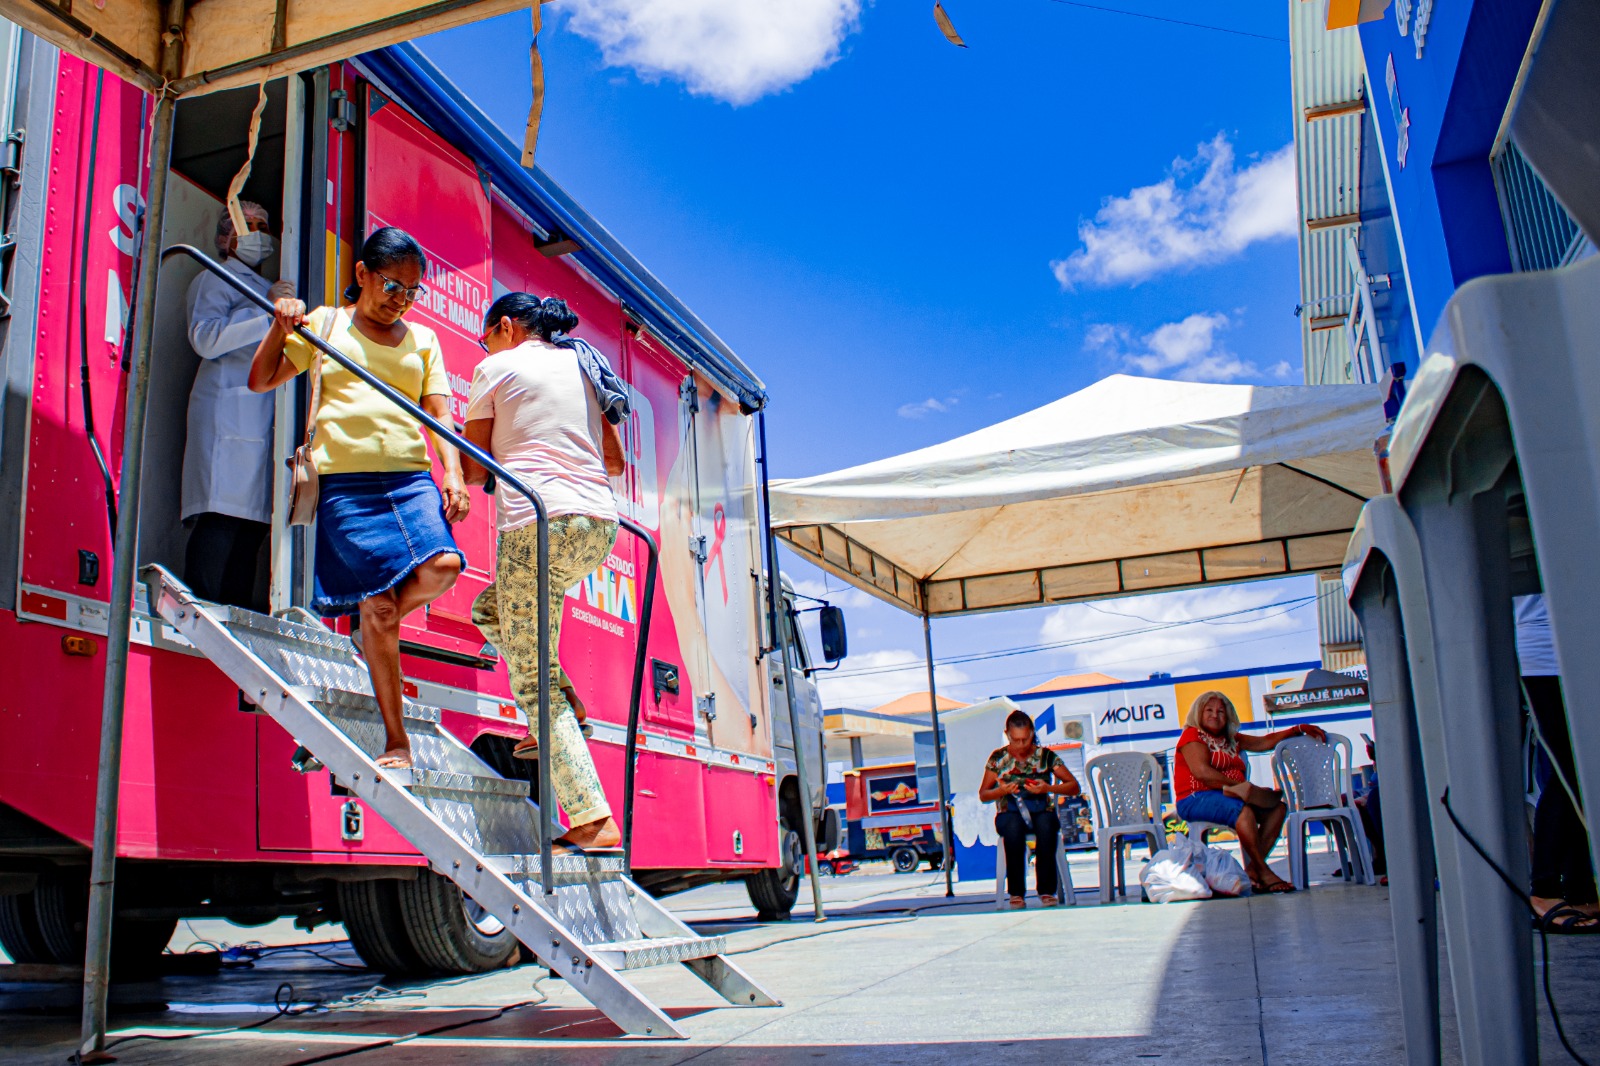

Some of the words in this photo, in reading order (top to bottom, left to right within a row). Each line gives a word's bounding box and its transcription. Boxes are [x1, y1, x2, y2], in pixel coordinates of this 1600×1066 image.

[426, 259, 480, 310] AMENTO
[448, 300, 481, 337] MAMA
[565, 562, 637, 625] AHIA
[571, 606, 602, 630] SECRETARIA
[602, 619, 610, 633] DA
[609, 622, 625, 638] SAÚDE
[1275, 689, 1330, 706] ACARAJÉ
[1332, 687, 1365, 699] MAIA
